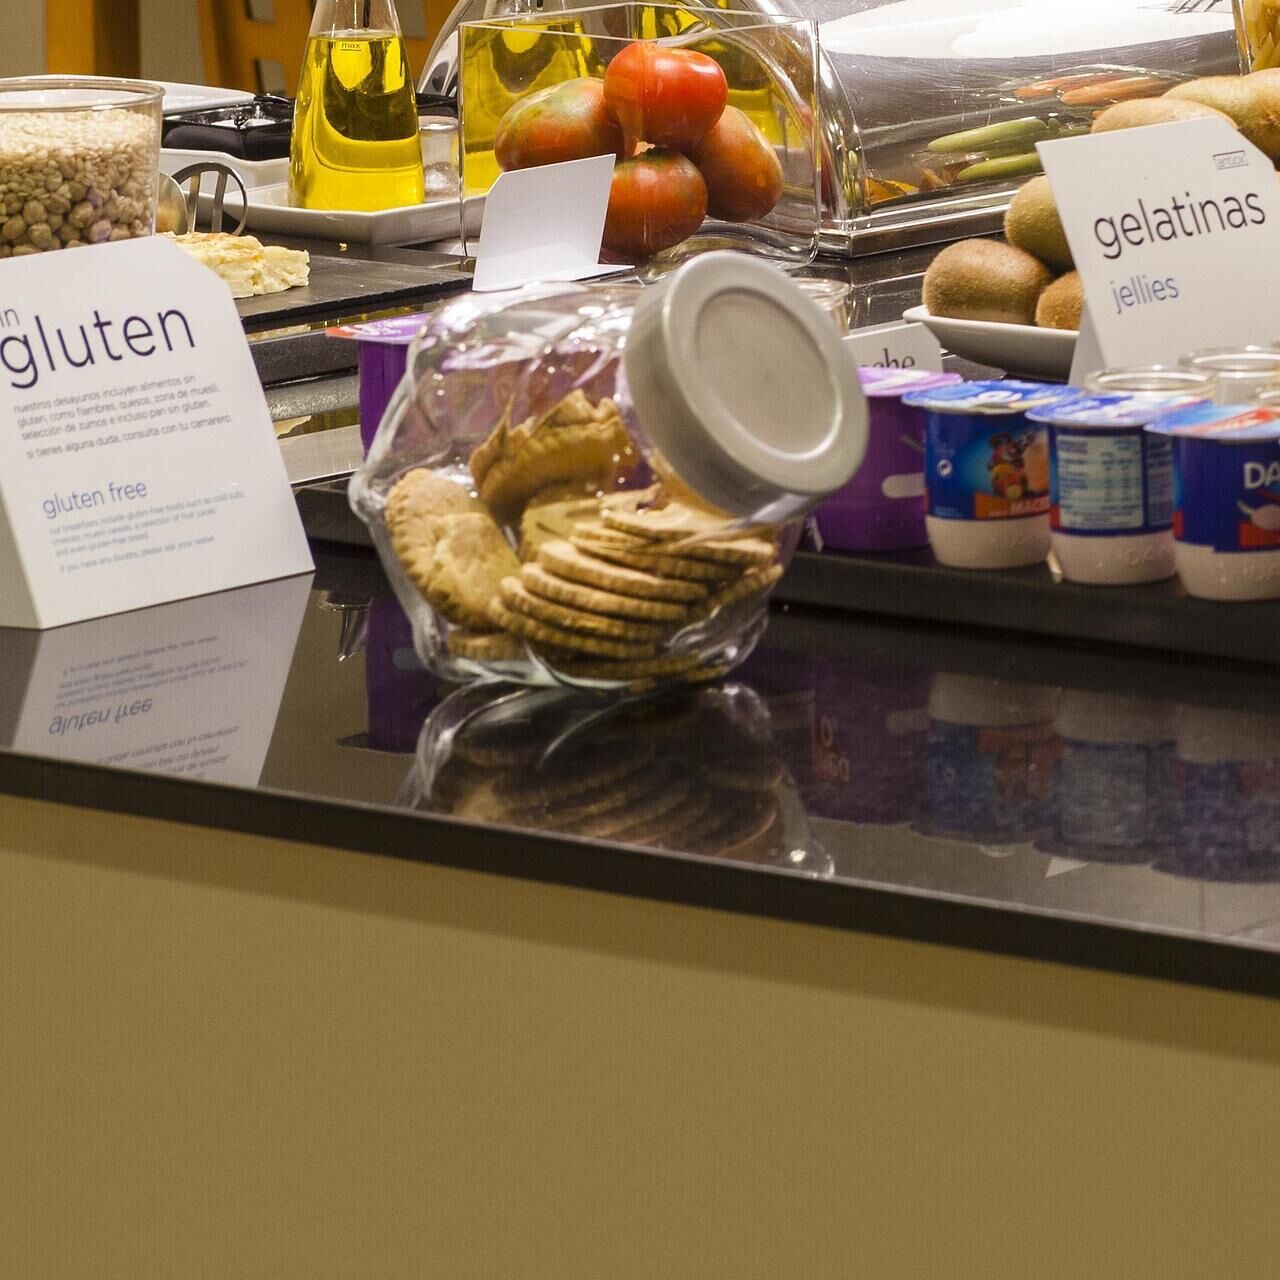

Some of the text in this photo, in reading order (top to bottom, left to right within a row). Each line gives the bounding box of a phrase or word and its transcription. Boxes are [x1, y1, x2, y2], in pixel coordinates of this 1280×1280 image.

[1094, 191, 1266, 260] gelatinas
[1109, 274, 1180, 315] jellies
[0, 309, 195, 389] gluten
[13, 375, 196, 413] nuestros desayunos incluyen alimentos sin
[49, 409, 76, 422] como
[154, 392, 175, 403] zona
[177, 389, 189, 399] de
[65, 423, 76, 433] de
[79, 419, 108, 431] zumos
[117, 411, 148, 422] incluso
[149, 407, 166, 419] pan
[167, 405, 180, 415] sin
[35, 446, 63, 457] tienes
[65, 439, 95, 453] alguna
[122, 427, 160, 440] consulta
[161, 424, 177, 434] con
[178, 422, 189, 431] tu
[42, 481, 148, 519] gluten free
